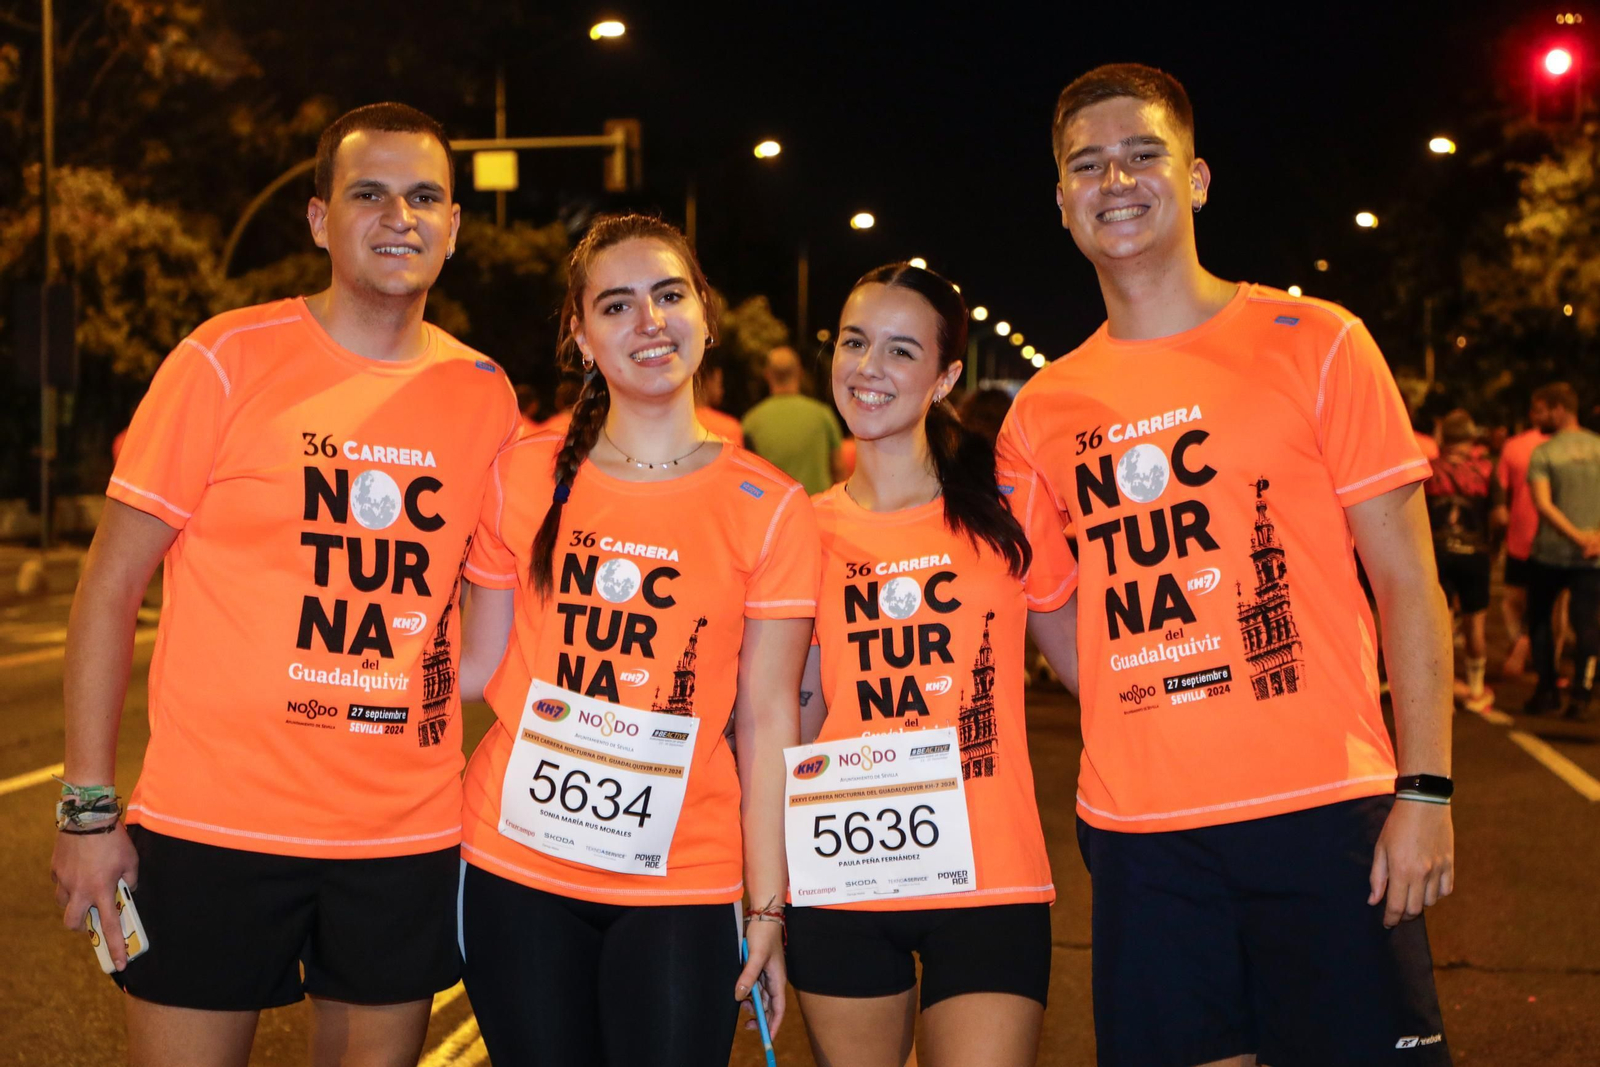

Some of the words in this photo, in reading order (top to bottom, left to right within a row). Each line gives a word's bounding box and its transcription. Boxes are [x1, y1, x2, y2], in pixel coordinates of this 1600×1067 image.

[1075, 426, 1103, 456] 36
[1108, 405, 1202, 443] CARRERA
[302, 432, 338, 458] 36
[343, 440, 436, 468] CARRERA
[569, 530, 596, 548] 36
[600, 537, 679, 562] CARRERA
[1086, 500, 1221, 576] TUR
[300, 532, 432, 597] TUR
[846, 562, 872, 580] 36
[875, 554, 952, 576] CARRERA
[1105, 572, 1197, 641] NA
[296, 595, 394, 659] NA
[557, 602, 658, 659] TUR
[1165, 628, 1184, 641] del
[848, 622, 955, 672] TUR
[1110, 634, 1221, 672] Guadalquivir
[288, 662, 409, 692] Guadalquivir
[361, 658, 380, 670] del
[557, 652, 620, 704] NA
[1166, 679, 1179, 690] 27
[1181, 669, 1228, 688] septiembre
[856, 675, 930, 722] NA
[1171, 690, 1206, 706] SEVILLA
[1207, 684, 1231, 697] 2024
[349, 722, 383, 735] SEVILLA
[384, 725, 404, 735] 2024
[351, 707, 363, 717] 27
[365, 709, 406, 721] septiembre
[904, 718, 919, 728] del
[524, 732, 540, 741] XXXVI
[540, 737, 563, 750] CARRERA
[564, 746, 595, 758] NOCTURNA
[608, 758, 653, 771] GUADALQUIVIR
[529, 759, 652, 828] 5634
[808, 794, 833, 802] CARRERA
[834, 790, 866, 799] NOCTURNA
[878, 784, 924, 795] GUADALQUIVIR
[505, 819, 535, 837] Cruzcampo
[540, 809, 560, 820] SONIA
[561, 815, 584, 827] MARÍA
[585, 821, 598, 830] RUS
[600, 826, 632, 838] MORALES
[813, 804, 940, 858] 5636
[634, 854, 661, 862] POWER
[838, 859, 861, 867] PAULA
[862, 857, 880, 865] PEÑA
[881, 854, 920, 863] FERNÁNDEZ
[937, 870, 968, 879] POWER
[798, 886, 836, 896] Cruzcampo
